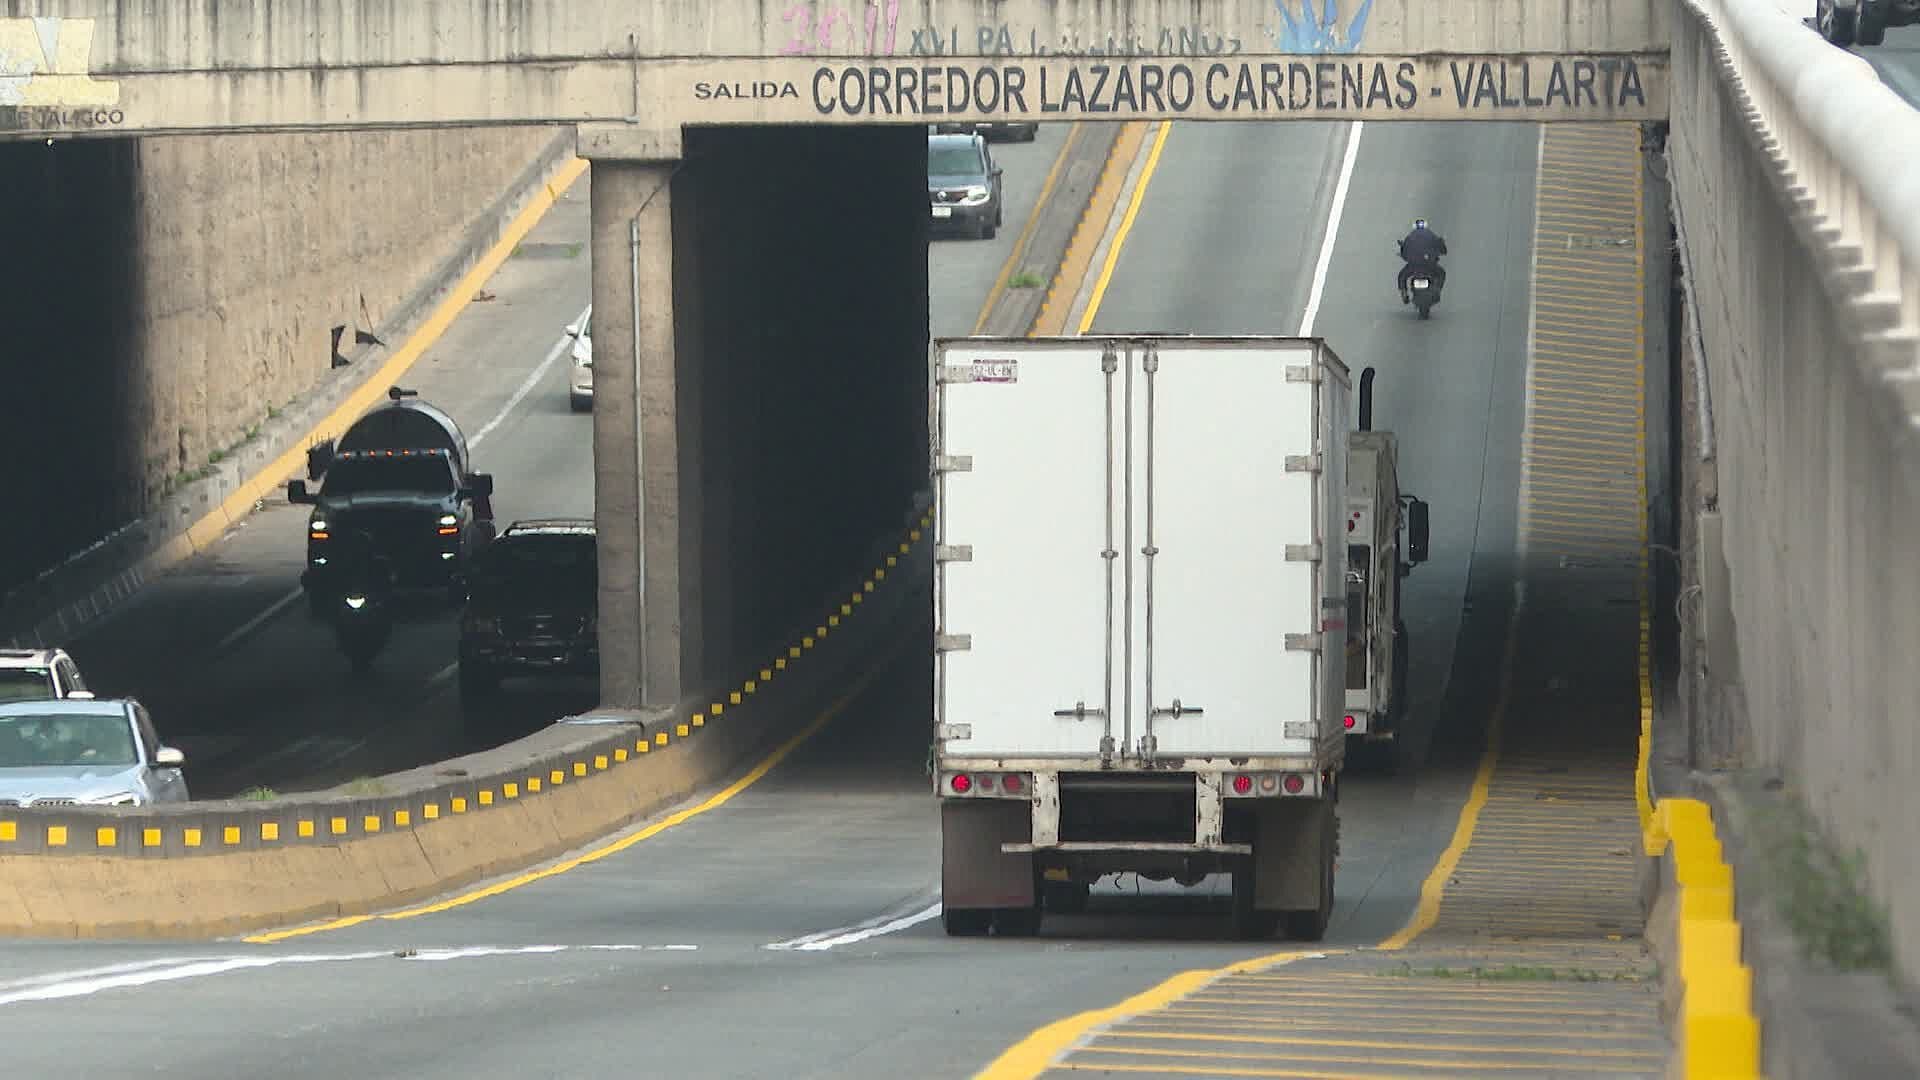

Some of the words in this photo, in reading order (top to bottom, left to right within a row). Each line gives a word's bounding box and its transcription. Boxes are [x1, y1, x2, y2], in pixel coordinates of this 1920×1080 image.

[695, 81, 800, 100] SALIDA
[812, 65, 1029, 115] CORREDOR
[1039, 63, 1195, 113] LAZARO
[1205, 62, 1418, 111] CARDENAS
[1450, 60, 1645, 109] VALLARTA
